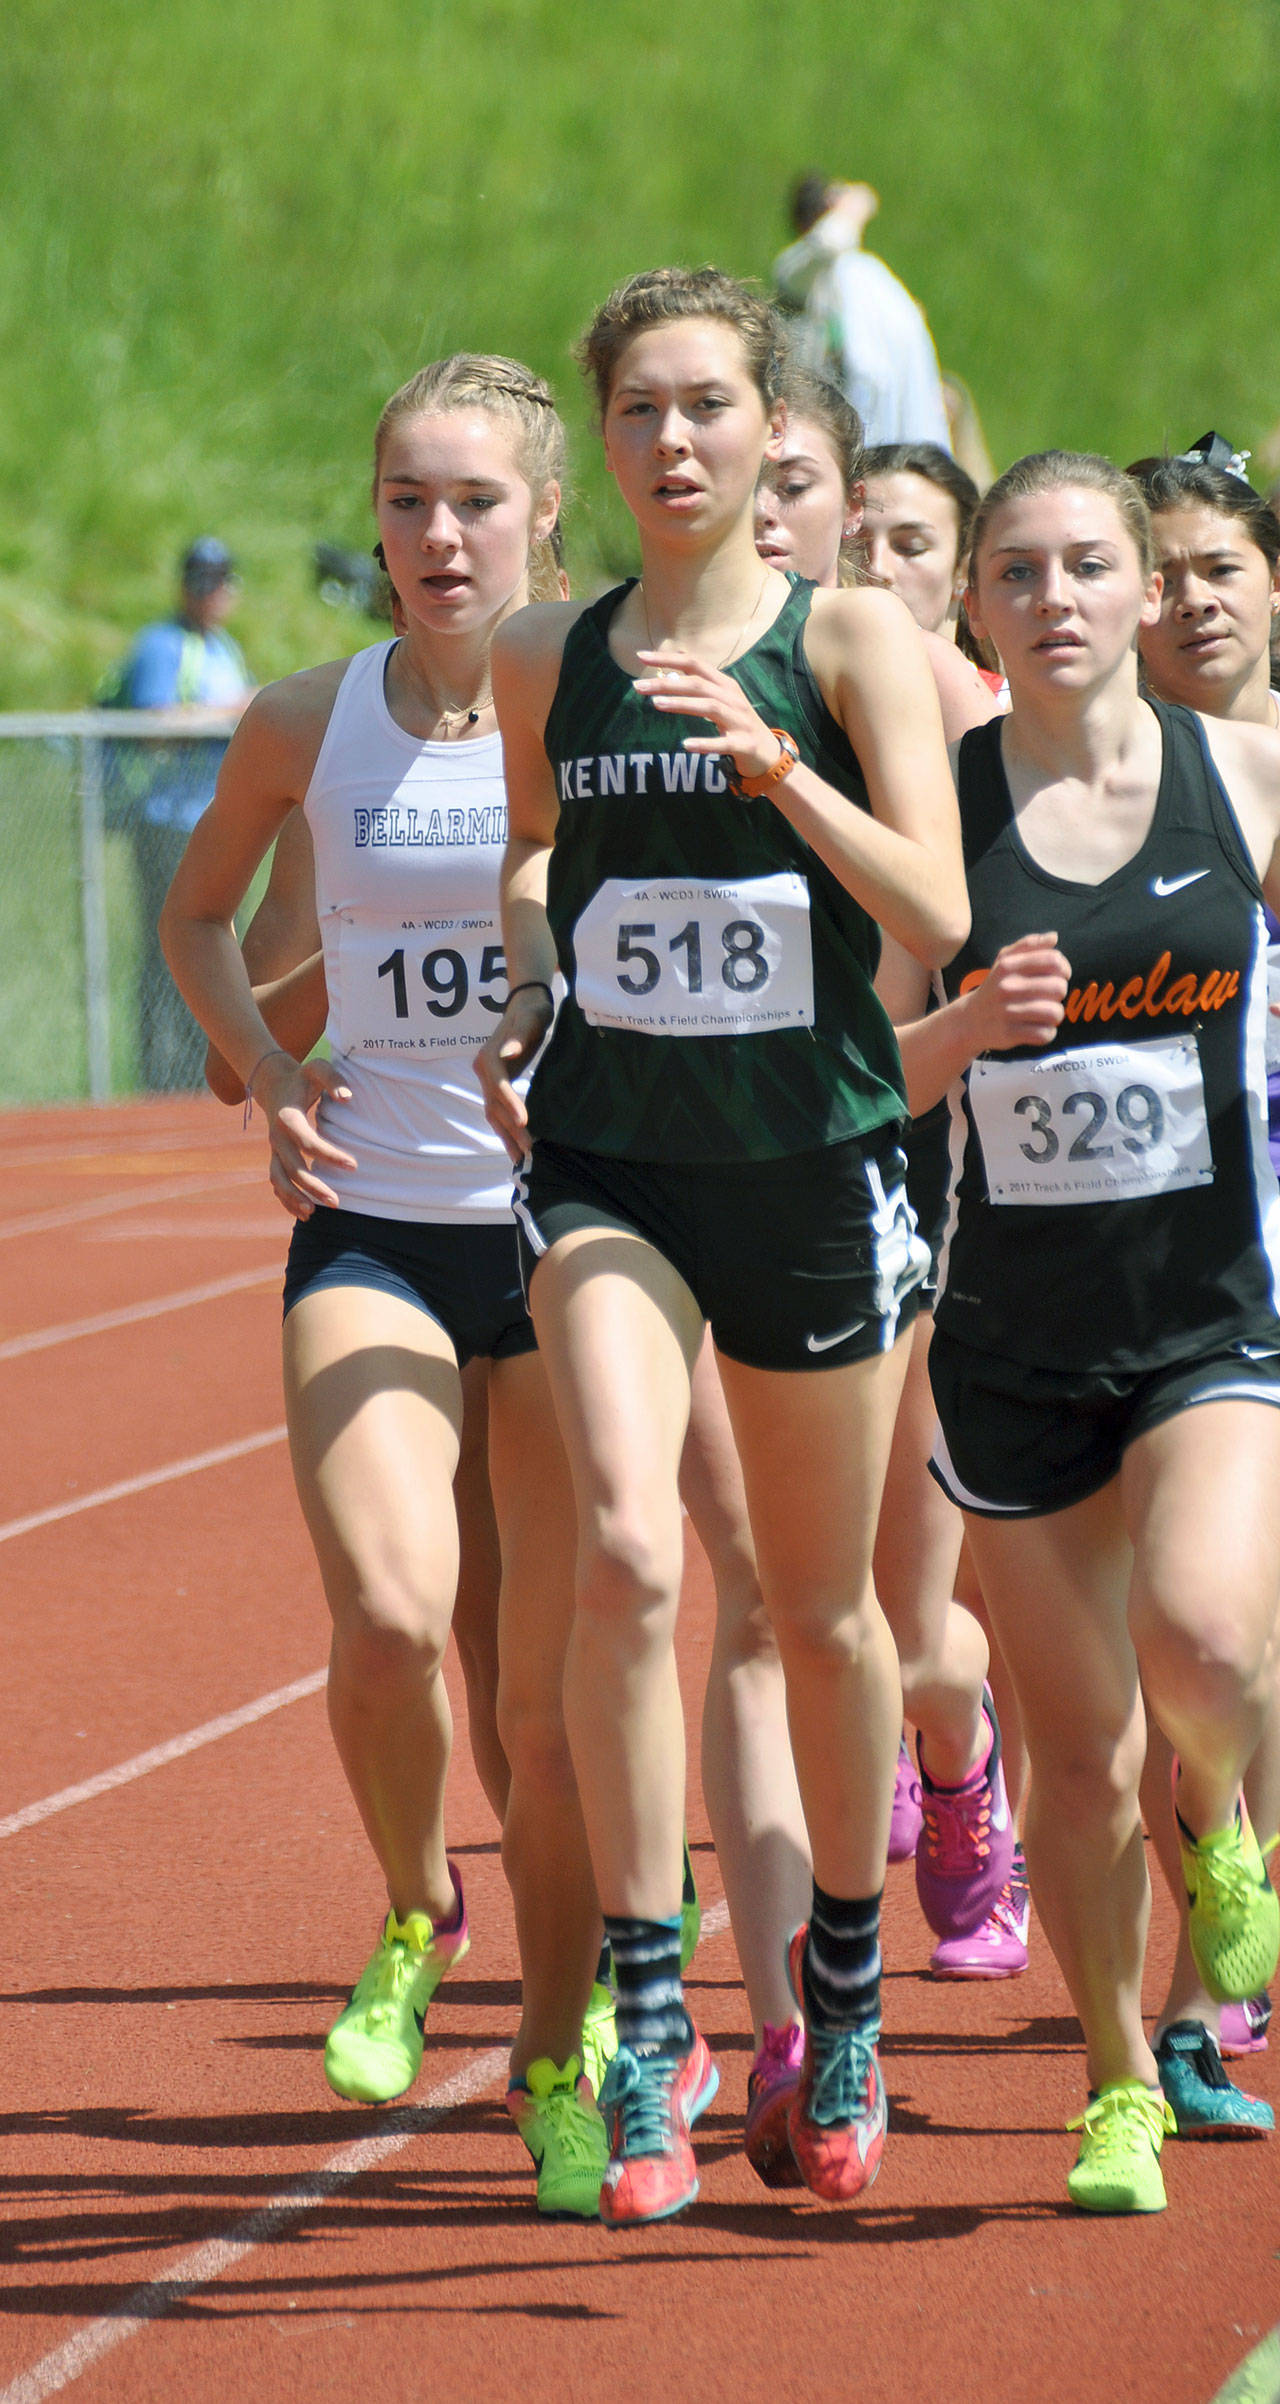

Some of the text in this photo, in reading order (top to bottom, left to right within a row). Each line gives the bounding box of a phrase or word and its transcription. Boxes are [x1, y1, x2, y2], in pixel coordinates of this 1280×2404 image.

[634, 891, 649, 901] 4A
[659, 890, 693, 901] WCD3
[703, 888, 738, 900] SWD4
[401, 921, 415, 930] 4A
[424, 919, 454, 930] WCD3
[461, 919, 493, 929] SWD4
[616, 919, 769, 995] 518
[377, 945, 509, 1018] 195
[960, 950, 1240, 1024] mclaw
[627, 1015, 655, 1026] Track
[659, 1015, 667, 1026] &
[670, 1013, 698, 1026] Field
[701, 1009, 791, 1026] Championships
[363, 1039, 389, 1049] 2017
[388, 1038, 416, 1049] Track
[418, 1038, 427, 1048] &
[430, 1035, 457, 1047] Field
[1052, 1060, 1087, 1073] WCD3
[1014, 1084, 1164, 1164] 329
[1009, 1182, 1031, 1193] 2017
